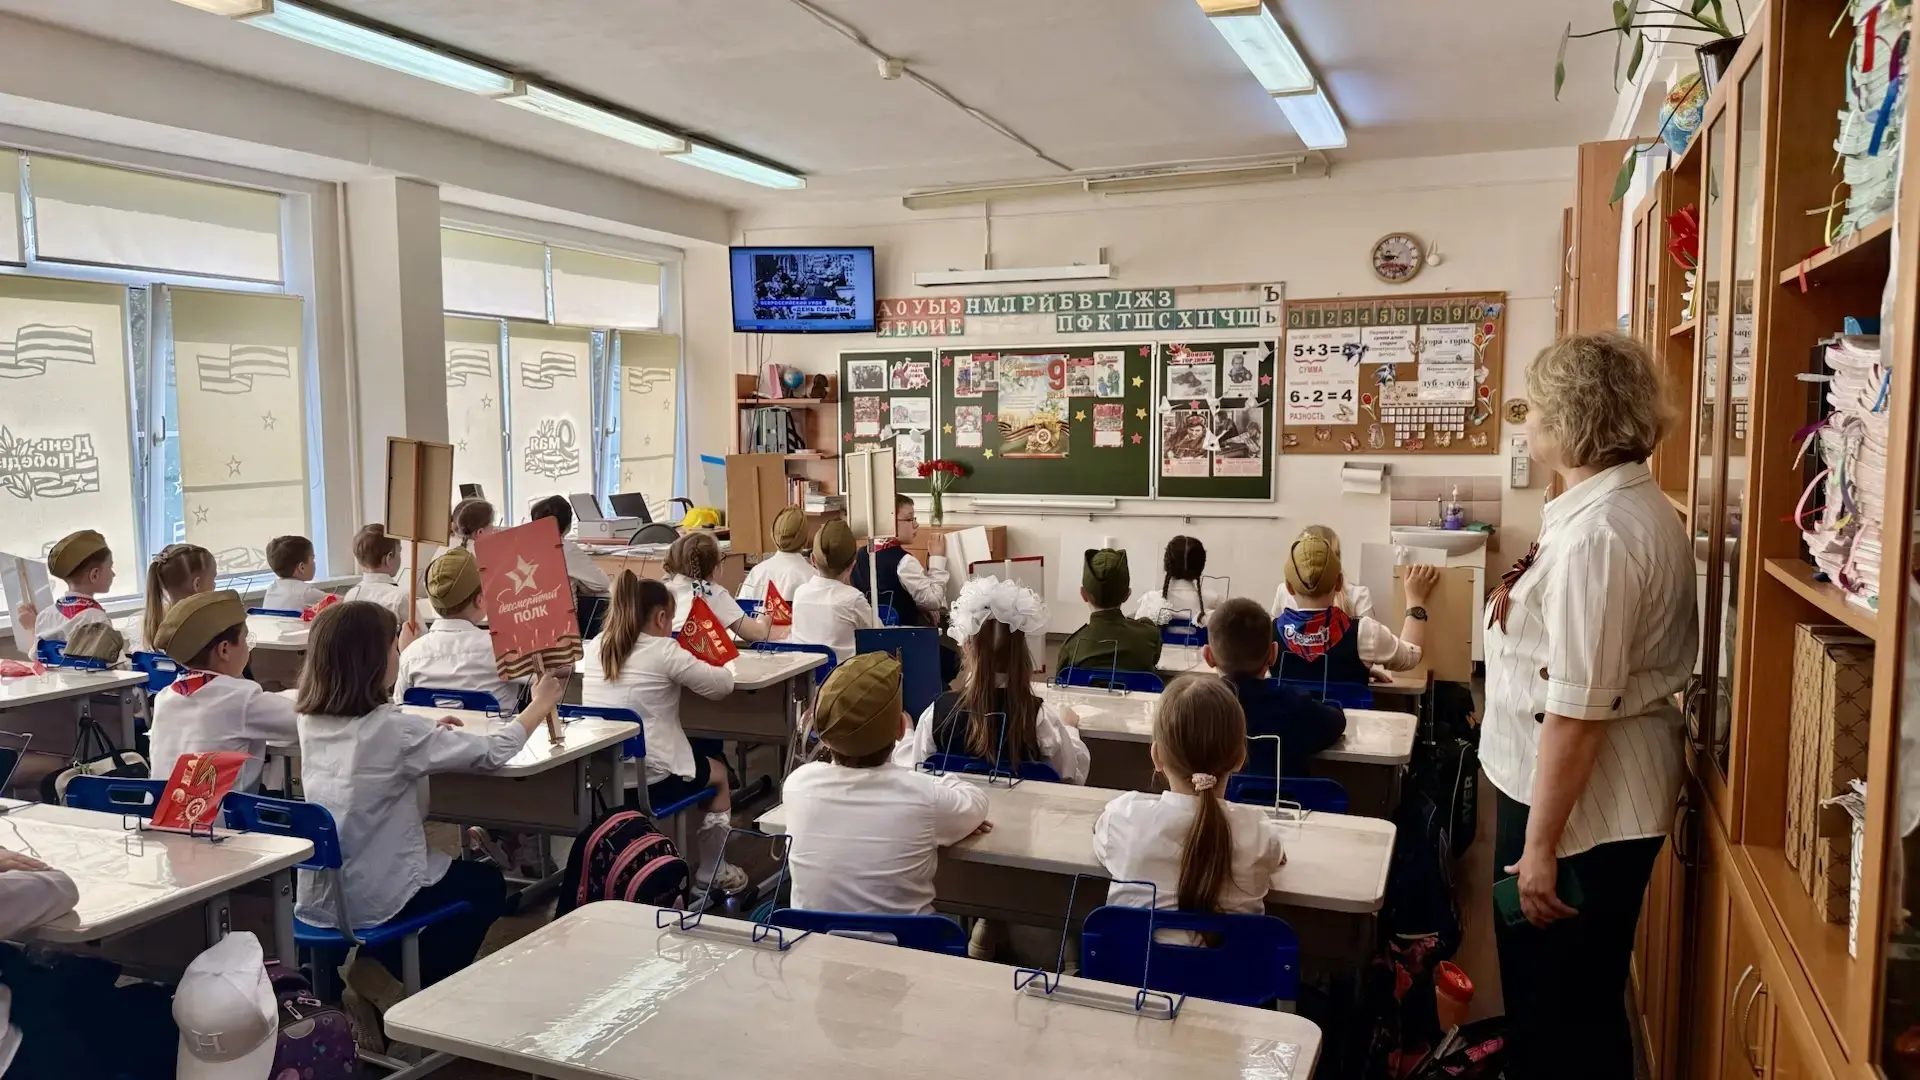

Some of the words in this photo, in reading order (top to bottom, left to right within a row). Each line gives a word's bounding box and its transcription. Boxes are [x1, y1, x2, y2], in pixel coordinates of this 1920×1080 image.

[1291, 312, 1300, 325] 0
[1310, 312, 1316, 325] 1
[1326, 312, 1335, 324] 2
[1344, 311, 1352, 323] 3
[1360, 310, 1369, 323] 4
[1379, 310, 1388, 322] 5
[1397, 309, 1406, 322] 6
[1416, 309, 1424, 321] 7
[1433, 308, 1442, 321] 8
[1452, 308, 1461, 320] 9
[1469, 307, 1483, 320] 10
[1048, 359, 1065, 390] 9
[1299, 366, 1323, 374] СУММА
[1289, 412, 1326, 421] РАЗНОСТЬ
[514, 604, 549, 624] ПОЛК
